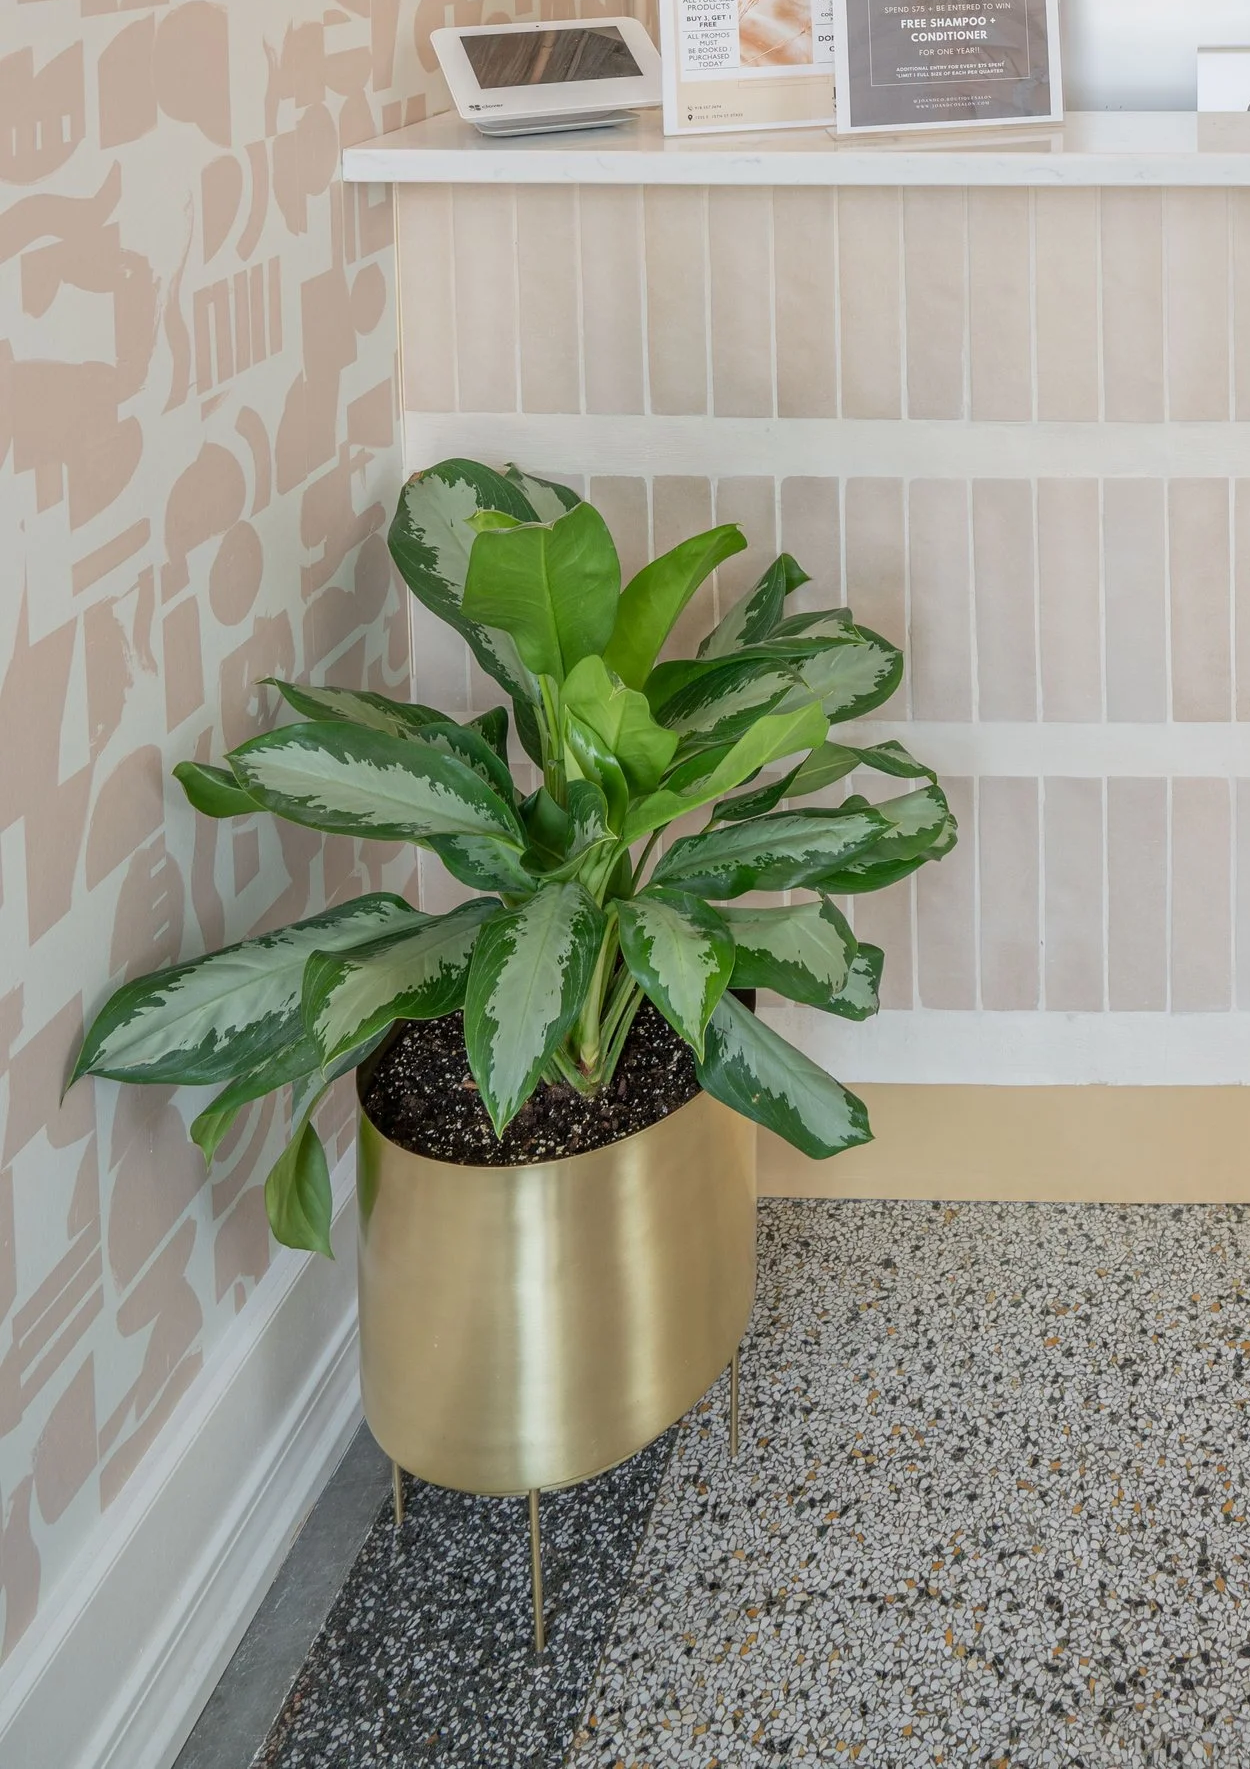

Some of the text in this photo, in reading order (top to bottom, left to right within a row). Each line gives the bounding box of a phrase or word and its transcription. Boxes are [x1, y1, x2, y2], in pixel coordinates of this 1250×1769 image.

[687, 3, 730, 11] PRODUCTS
[884, 6, 909, 14] SPEND
[911, 5, 925, 13] $75
[935, 4, 946, 12] BE
[947, 3, 981, 11] ENTERED
[995, 2, 1011, 10] WIN
[900, 19, 927, 29] FREE
[930, 16, 987, 28] SHAMPOO
[910, 30, 988, 43] CONDITIONER
[698, 46, 728, 54] BOOKED
[919, 46, 980, 56] FOR ONE YEAR!!
[688, 53, 730, 61] PURCHASED
